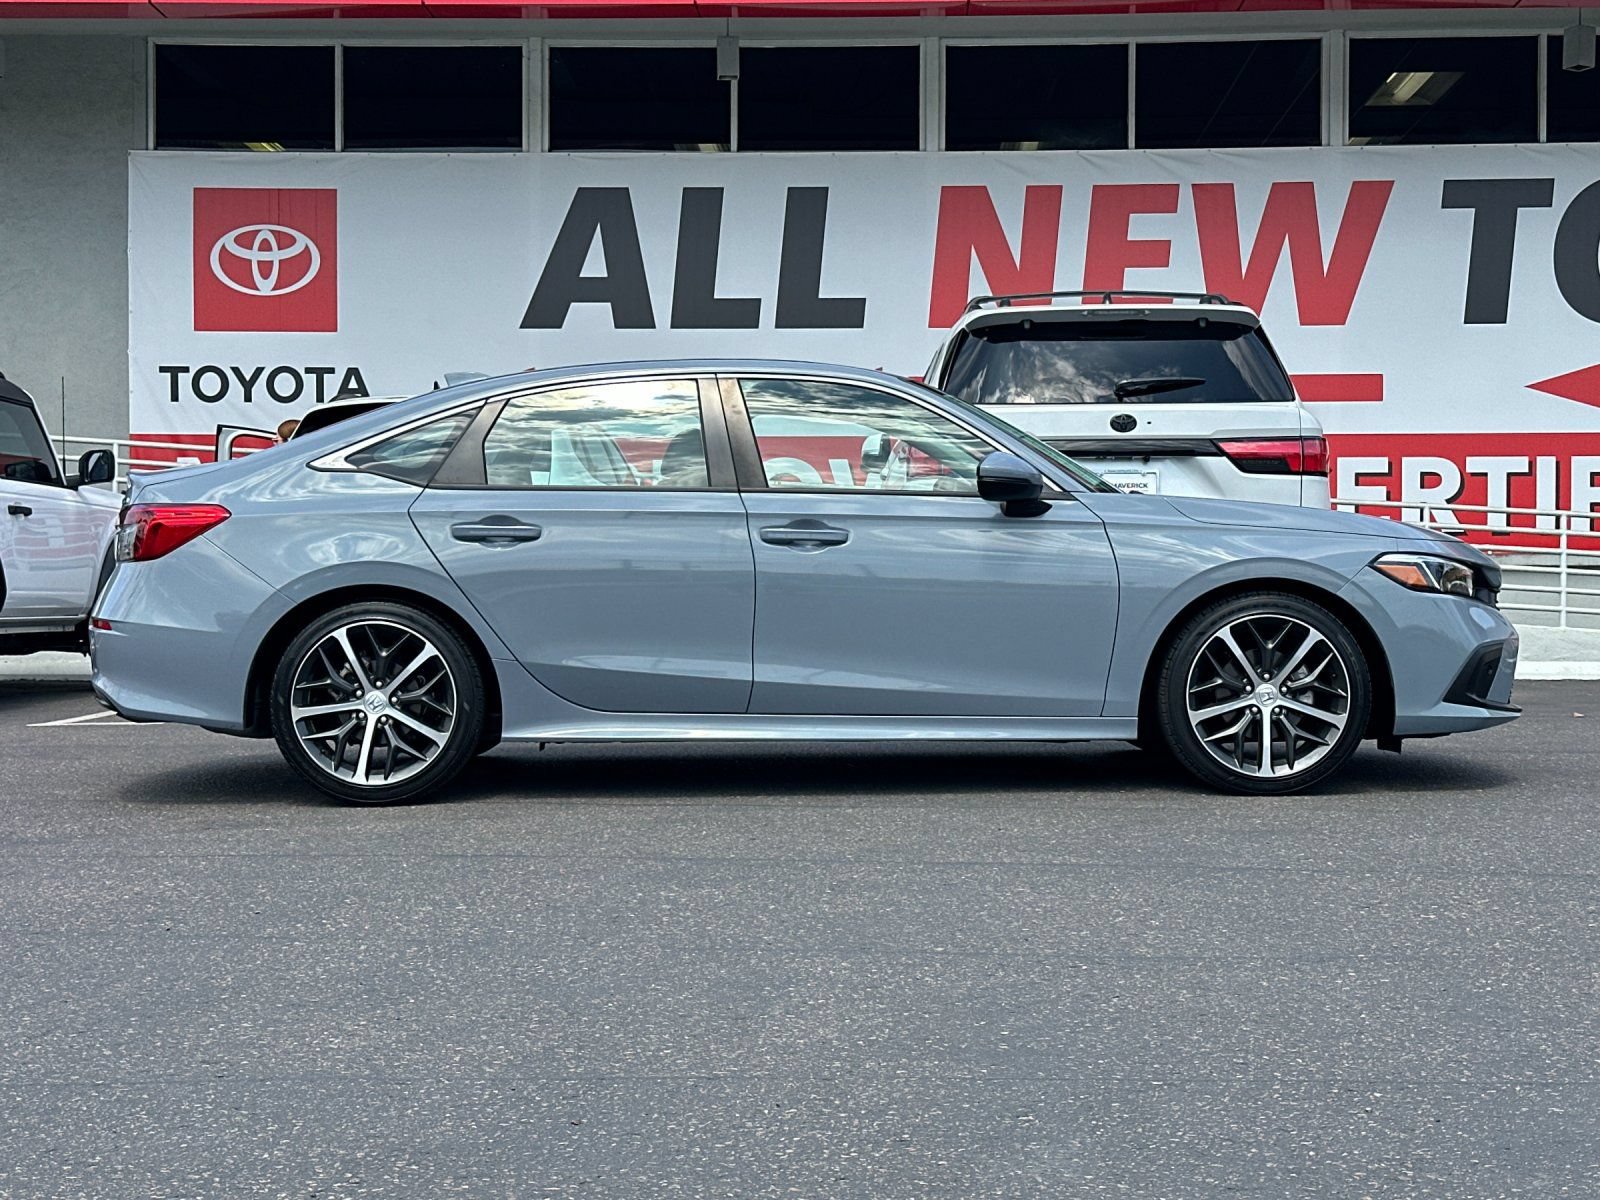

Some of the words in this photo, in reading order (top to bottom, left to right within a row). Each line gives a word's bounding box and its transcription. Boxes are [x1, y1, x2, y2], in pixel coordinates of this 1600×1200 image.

[519, 186, 867, 330] ALL
[928, 179, 1395, 329] NEW
[158, 364, 370, 404] TOYOTA
